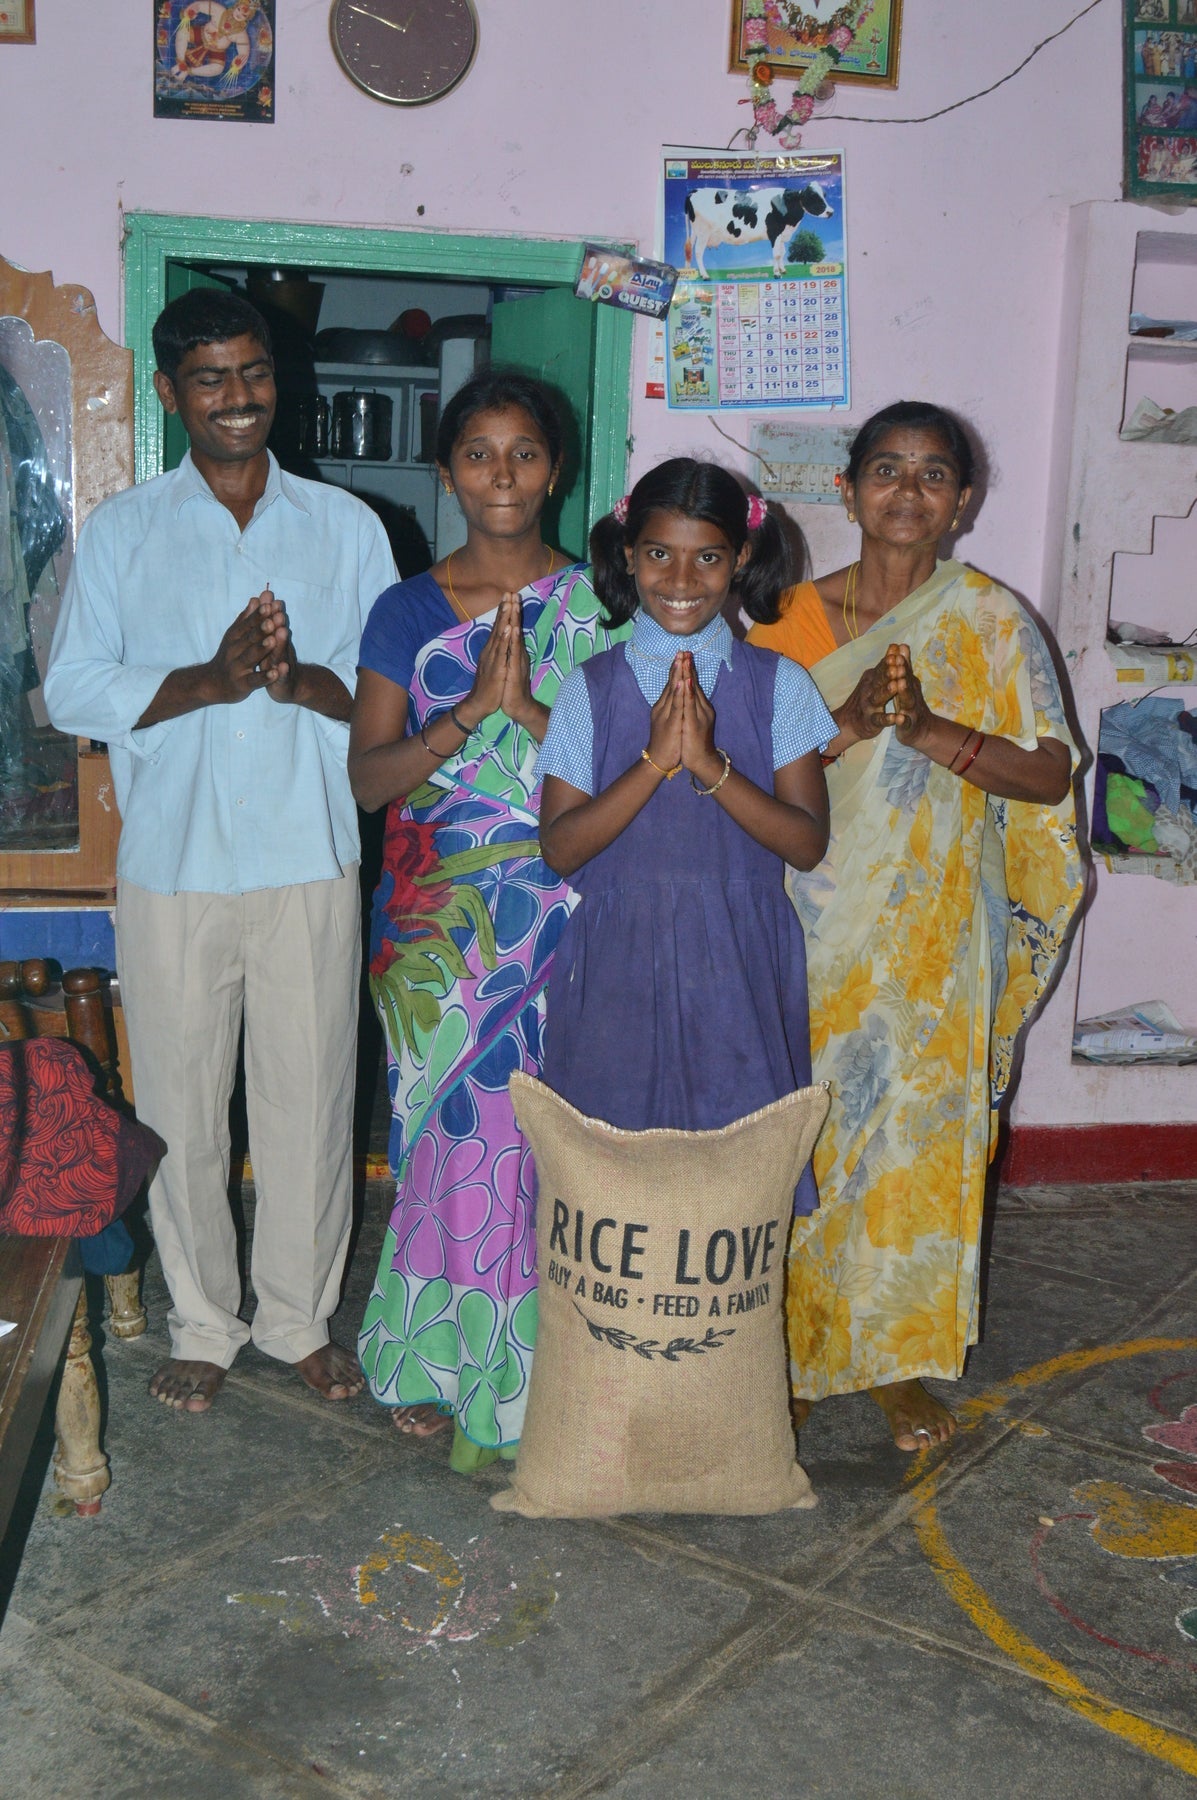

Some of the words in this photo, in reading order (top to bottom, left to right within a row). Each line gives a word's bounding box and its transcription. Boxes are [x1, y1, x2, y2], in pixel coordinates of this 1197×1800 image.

[816, 265, 836, 274] 2018
[631, 272, 661, 290] Ajay
[618, 291, 664, 311] QUEST
[549, 1198, 648, 1280] RICE
[675, 1219, 779, 1285] LOVE
[548, 1258, 571, 1289] BUY
[575, 1275, 586, 1298] A
[592, 1284, 629, 1309] BAG
[653, 1294, 700, 1318] FEED
[709, 1295, 721, 1317] A
[727, 1282, 772, 1315] FAMILY
